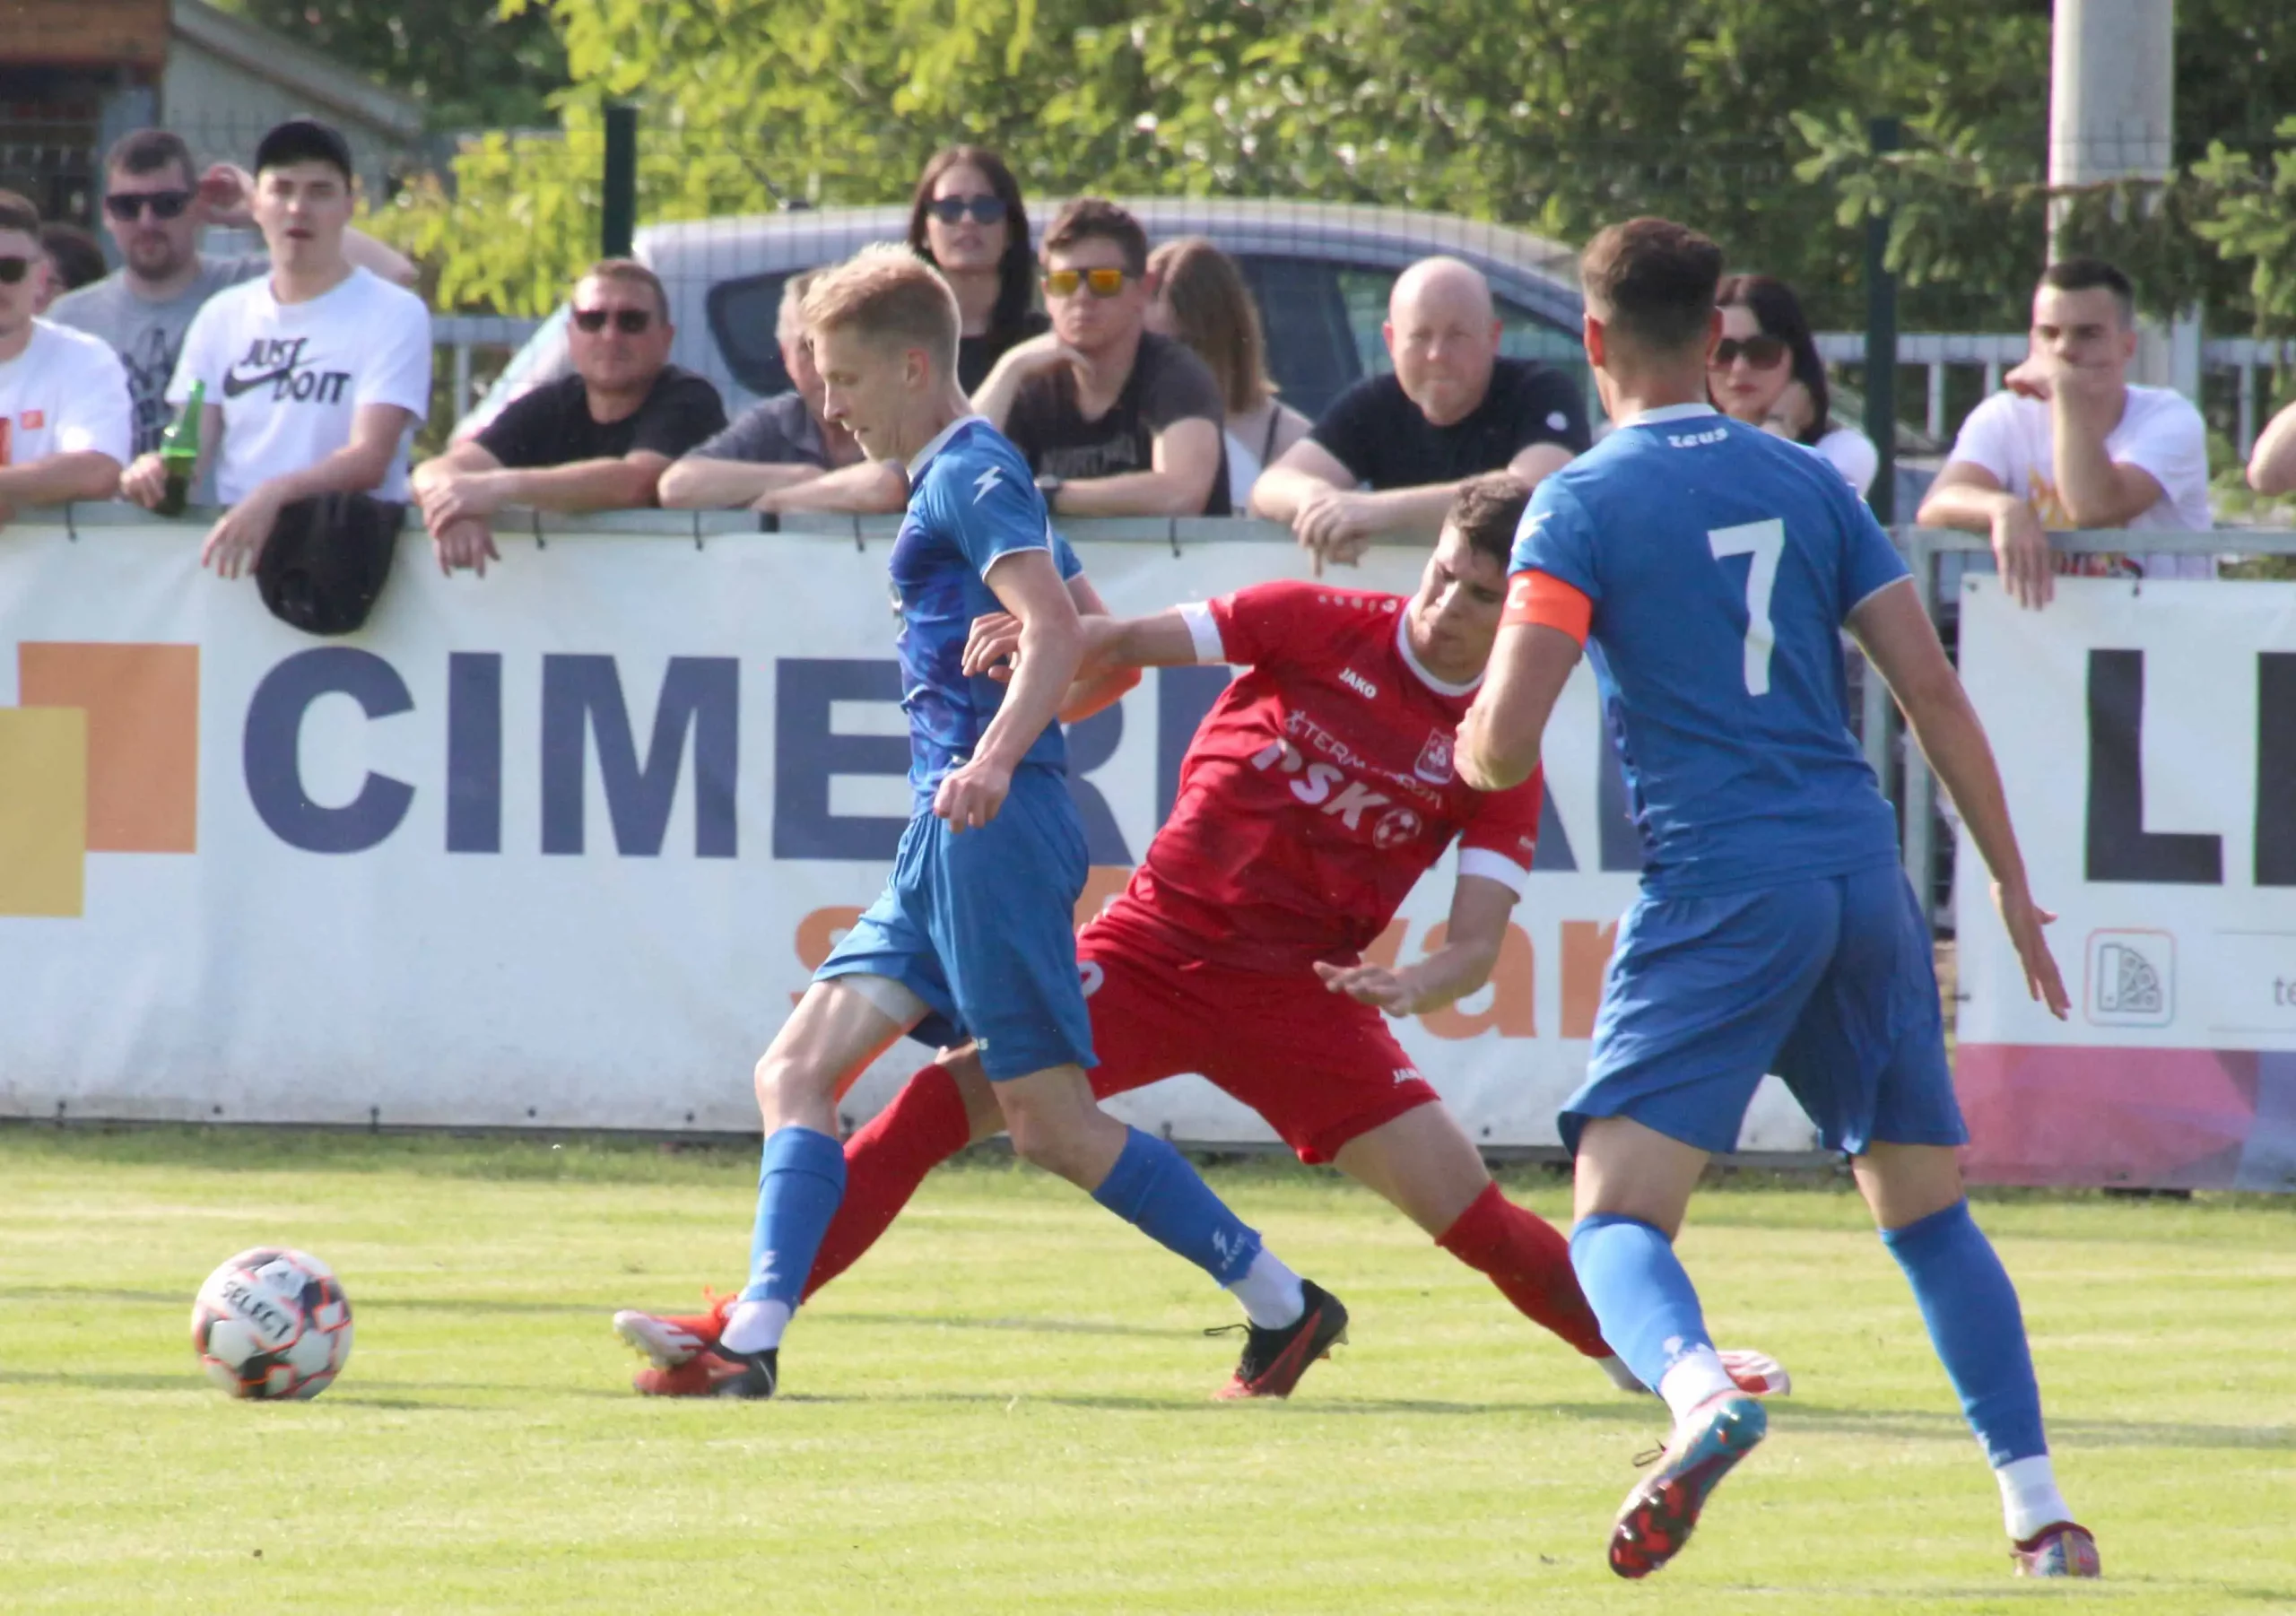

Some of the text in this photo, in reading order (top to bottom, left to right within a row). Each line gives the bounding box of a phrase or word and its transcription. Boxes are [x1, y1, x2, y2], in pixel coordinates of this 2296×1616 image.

[239, 337, 308, 369] JUST
[1507, 577, 1530, 609] C
[1707, 517, 1786, 697] 7
[1338, 667, 1378, 699] JAKO
